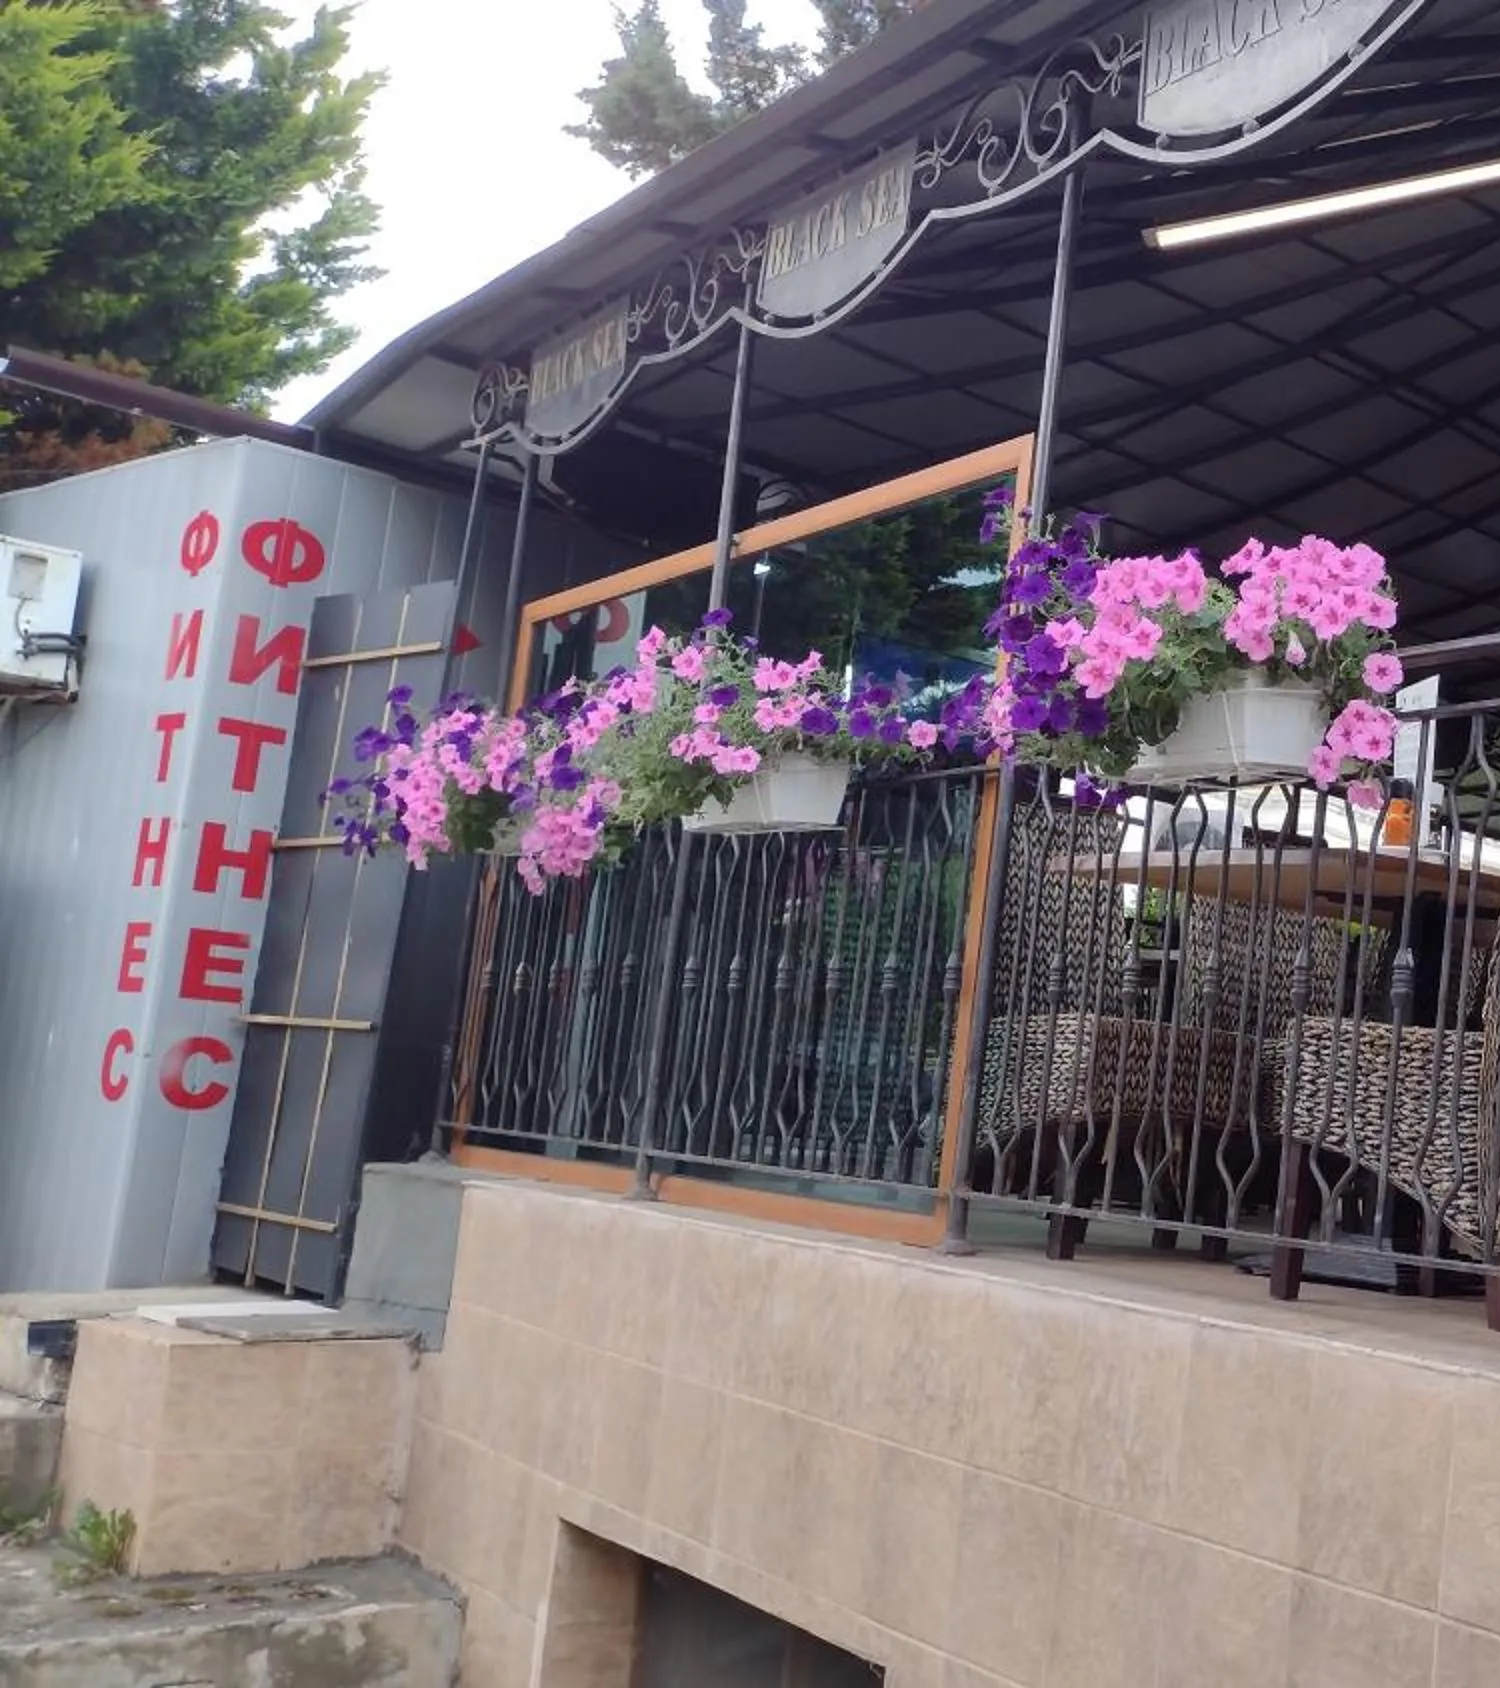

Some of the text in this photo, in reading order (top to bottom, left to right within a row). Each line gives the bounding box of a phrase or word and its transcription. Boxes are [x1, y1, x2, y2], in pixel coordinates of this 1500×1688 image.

[529, 336, 586, 406] BLACK
[765, 163, 908, 281] BLACK SEA
[101, 509, 222, 1103] ФИТНЕС
[159, 517, 327, 1112] ФИТНЕС
